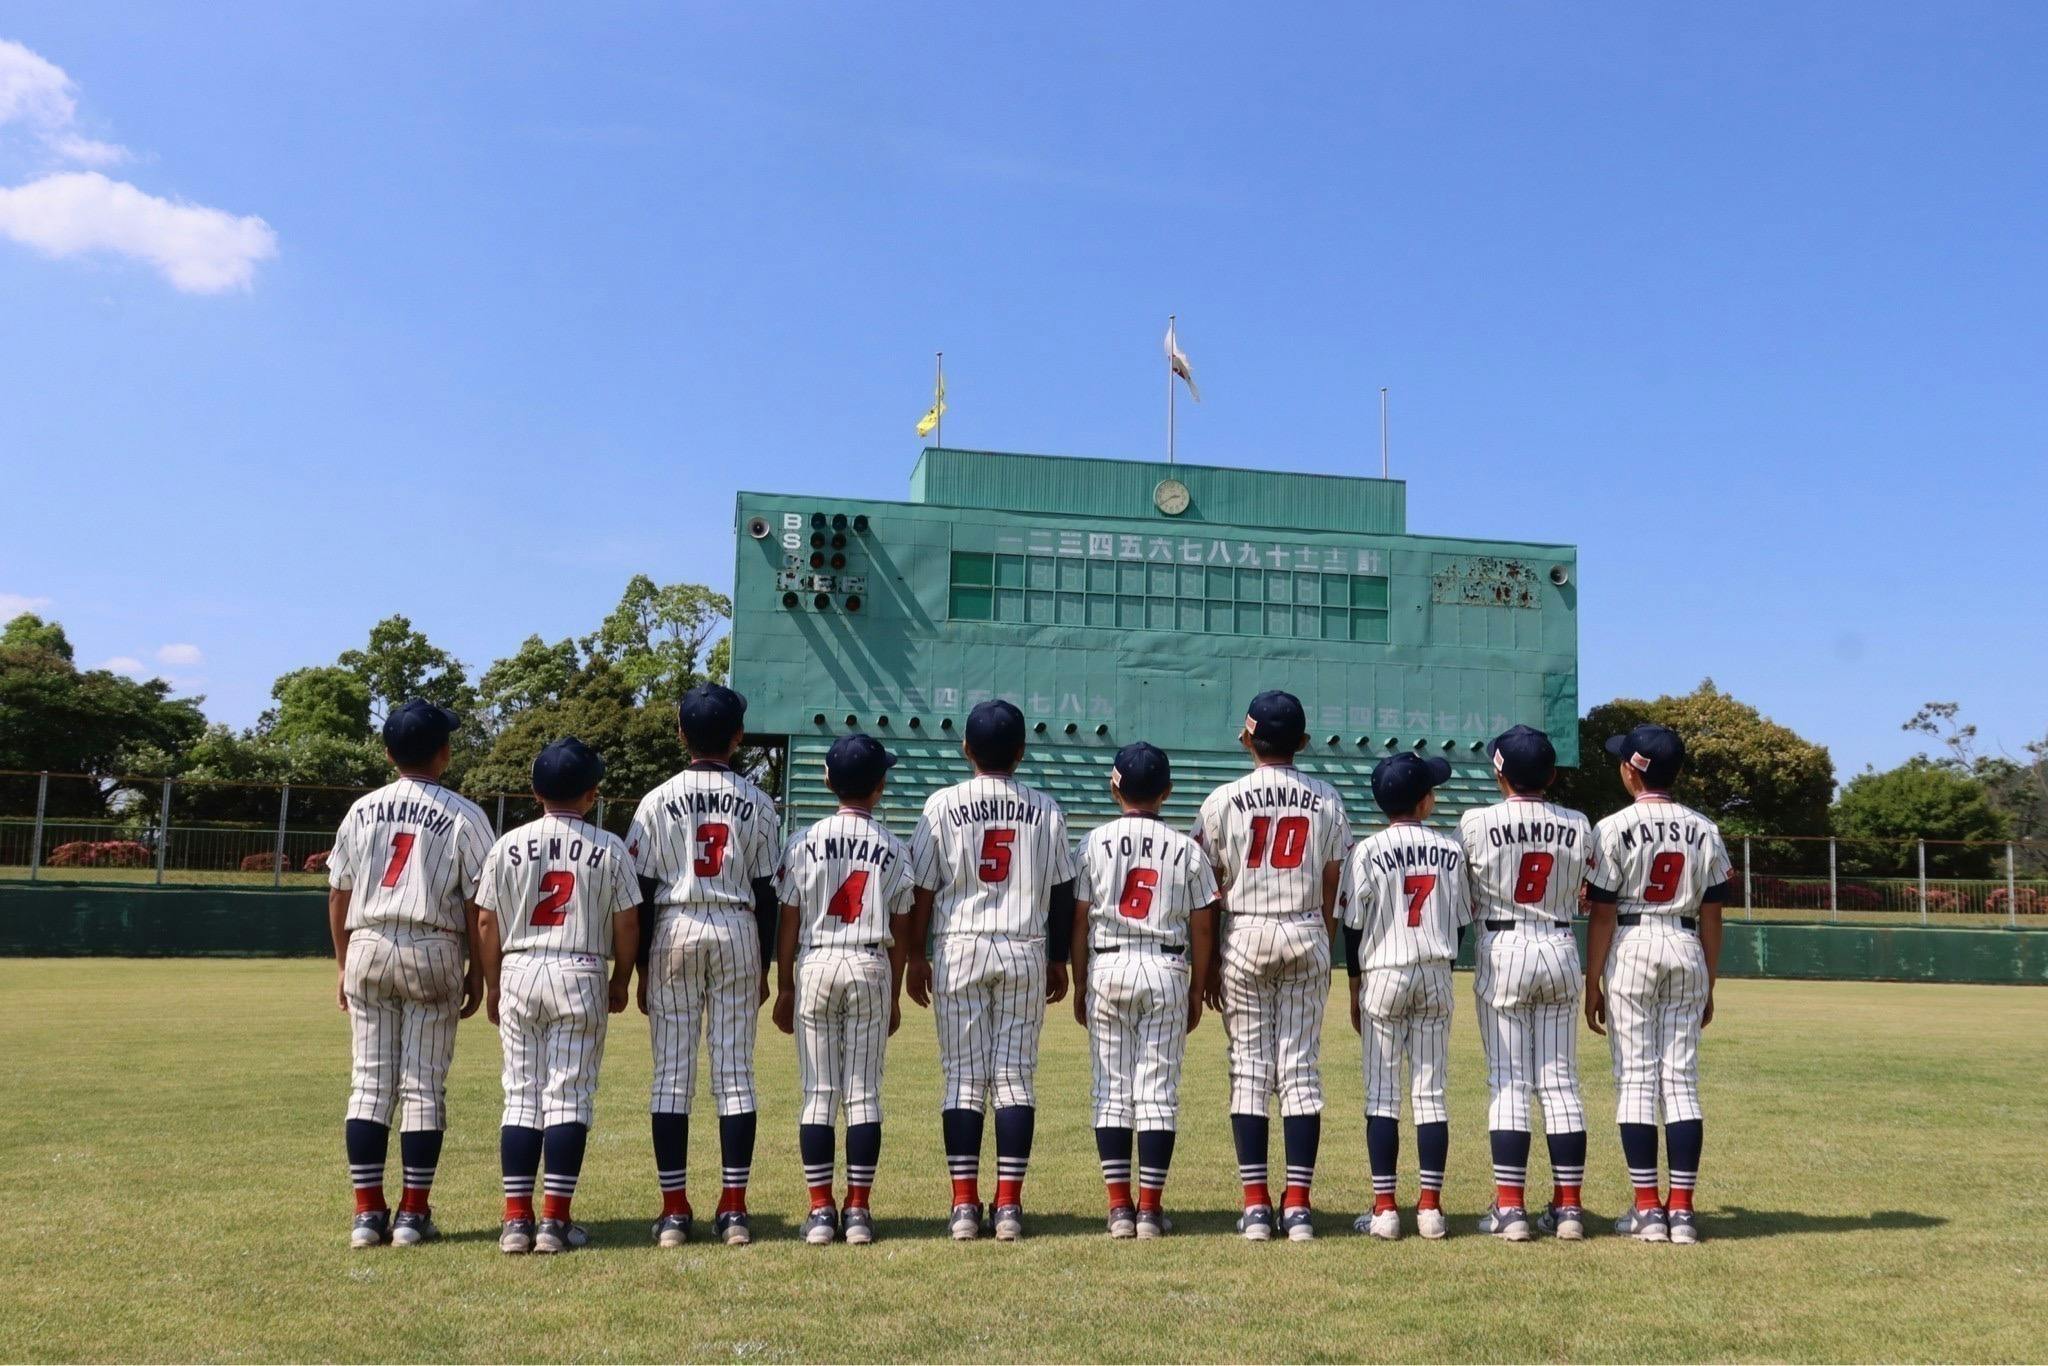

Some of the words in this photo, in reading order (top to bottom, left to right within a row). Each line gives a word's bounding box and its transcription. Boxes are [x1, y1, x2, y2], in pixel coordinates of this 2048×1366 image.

[783, 513, 802, 530] B
[783, 533, 801, 549] S
[665, 792, 754, 821] MIYAMOTO
[949, 800, 1041, 827] URUSHIDANI
[1231, 787, 1323, 814] WATANABE
[357, 802, 453, 836] T.TAKAHASHI
[1489, 822, 1577, 848] OKAMOTO
[1621, 821, 1706, 850] MATSUI
[381, 832, 416, 887] 1
[508, 838, 606, 868] SENOH
[694, 823, 729, 878] 3
[806, 837, 896, 873] Y.MIYAKE
[979, 828, 1016, 883] 5
[1102, 836, 1186, 867] TORII
[1246, 816, 1310, 869] 10
[1372, 845, 1459, 874] YAMAMOTO
[1119, 867, 1158, 920] 6
[1514, 852, 1554, 904] 8
[1643, 851, 1685, 903] 9
[529, 870, 575, 926] 2
[827, 870, 870, 924] 4
[1404, 874, 1436, 927] 7
